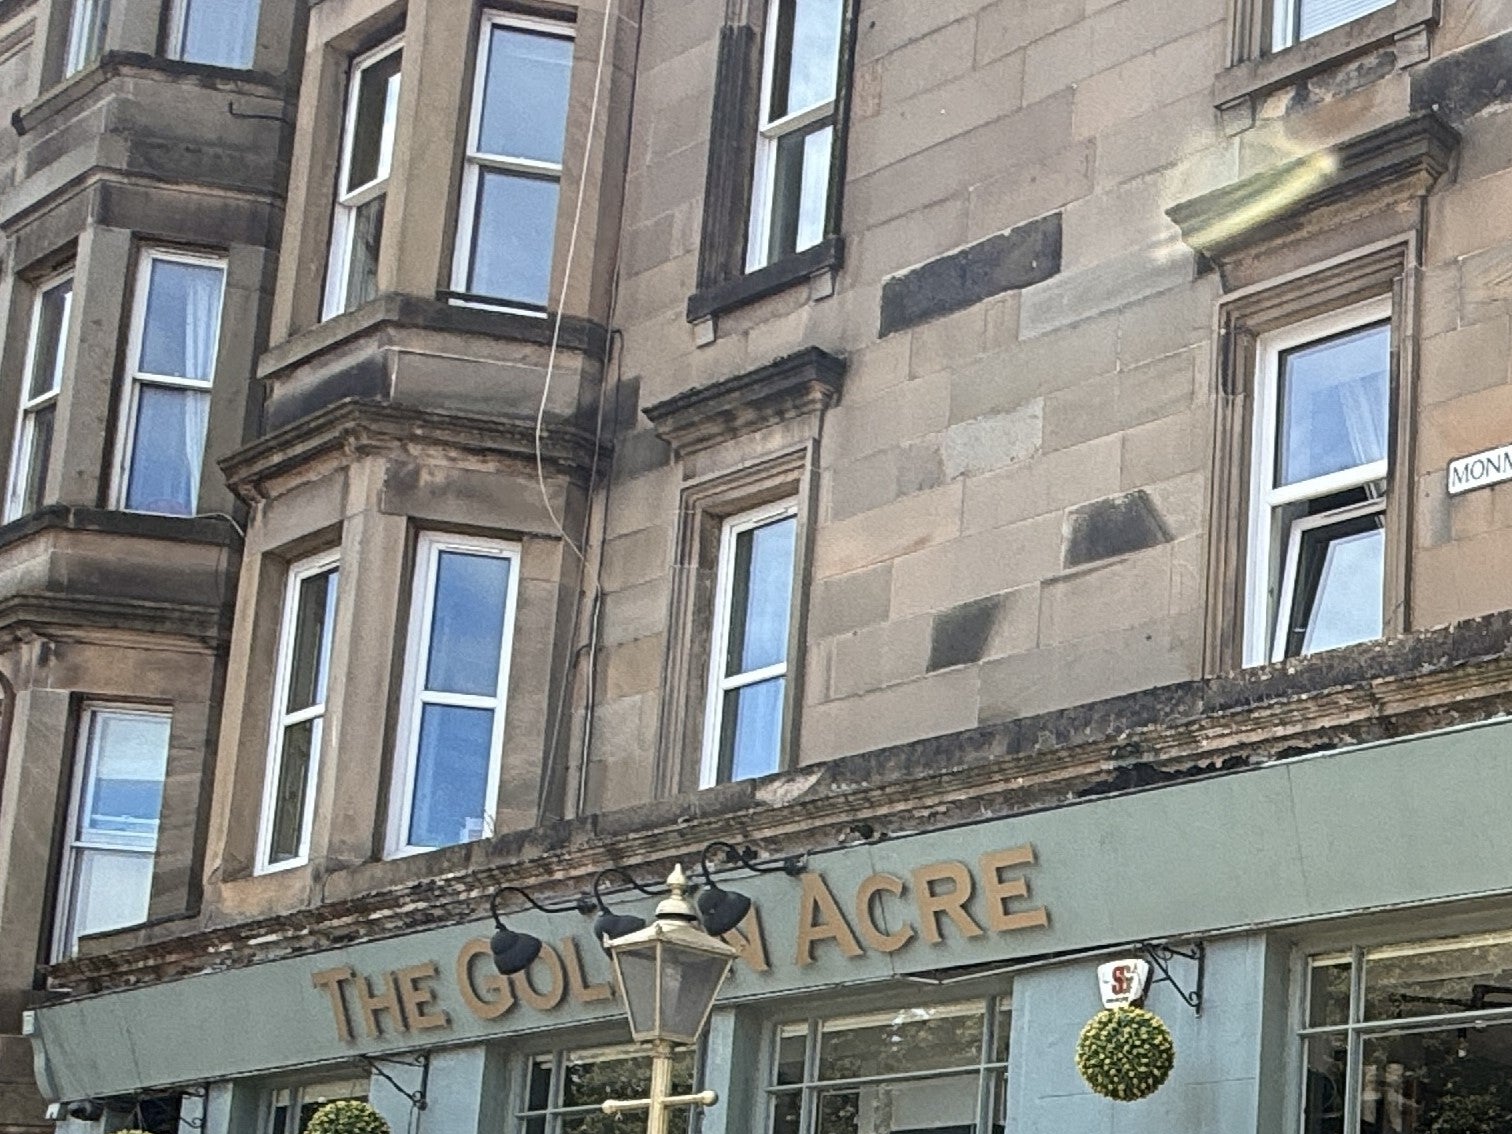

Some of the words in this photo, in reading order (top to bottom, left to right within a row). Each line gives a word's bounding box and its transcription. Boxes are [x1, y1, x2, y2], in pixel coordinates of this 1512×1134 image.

[312, 961, 449, 1042] THE
[456, 900, 769, 1020] GOLN
[795, 842, 1049, 965] ACRE
